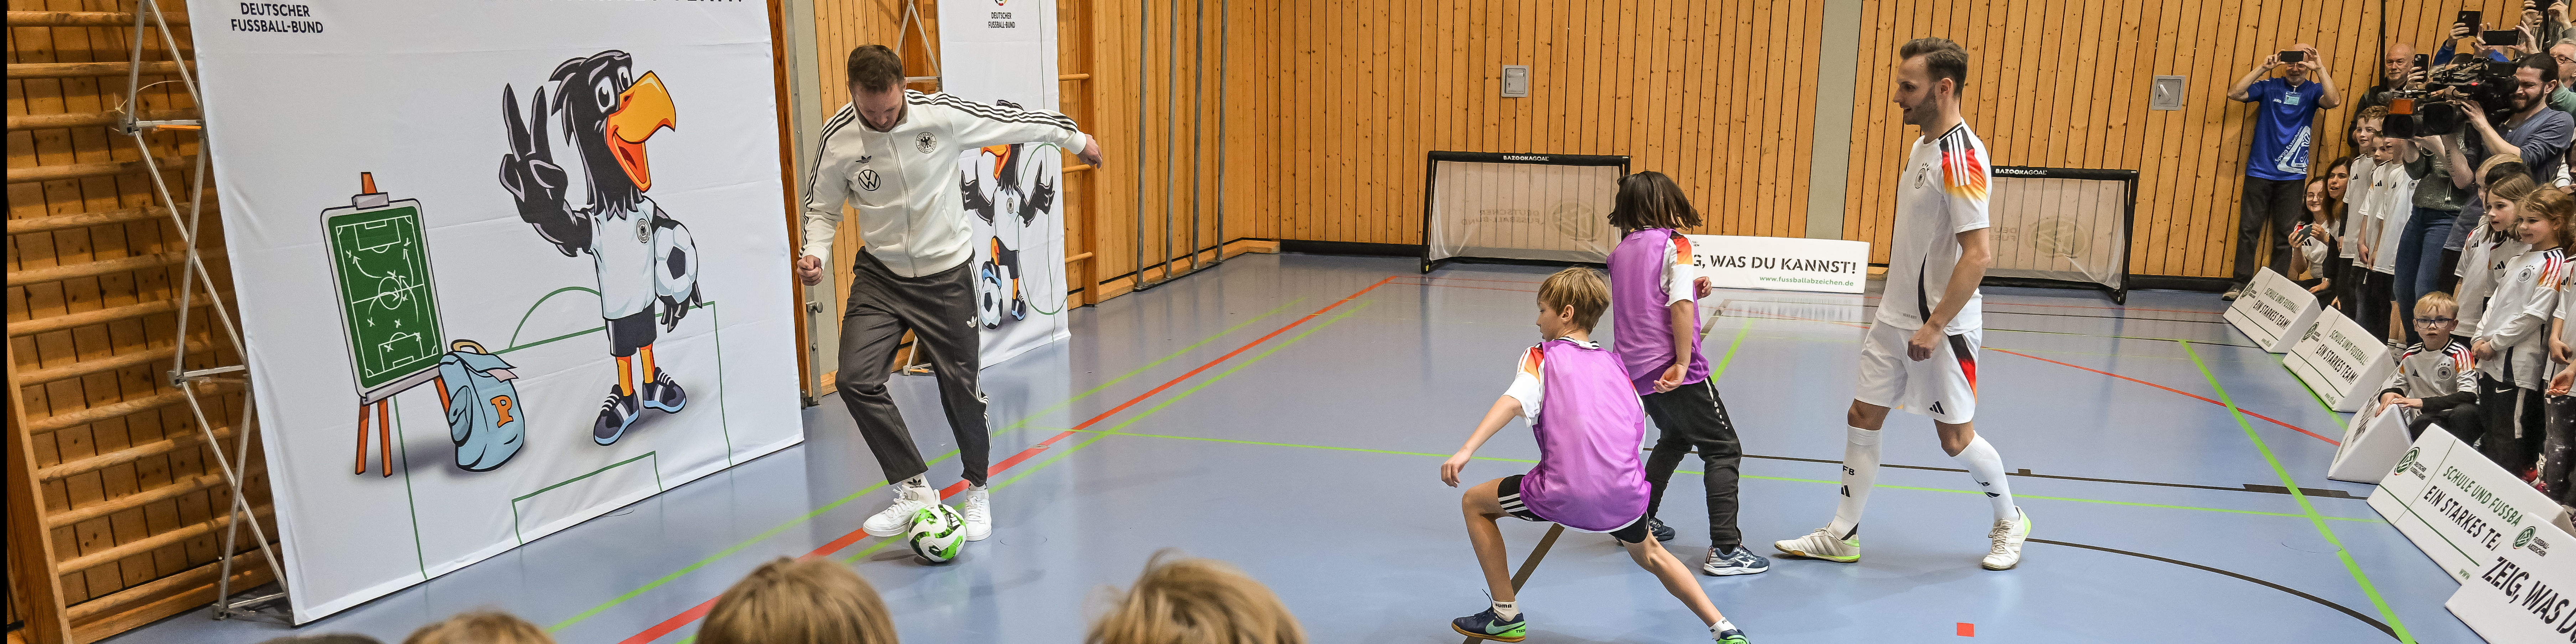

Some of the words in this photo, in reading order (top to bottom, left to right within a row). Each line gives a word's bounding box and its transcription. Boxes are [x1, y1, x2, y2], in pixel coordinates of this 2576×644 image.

[241, 2, 310, 17] DEUTSCHER
[231, 19, 323, 33] FUSSBALL-BUND
[2286, 126, 2303, 150] Essenheim
[1711, 255, 1746, 268] WAS
[1752, 257, 1775, 269] DU
[1781, 258, 1856, 274] KANNST!
[1760, 276, 1854, 286] www.fussballabzeichen.de
[2264, 288, 2279, 302] SCHULE
[2275, 294, 2285, 304] UND
[2253, 300, 2264, 311] EIN
[2259, 304, 2279, 321] STARKES
[2274, 314, 2291, 330] TEAM!
[2329, 330, 2346, 345] SCHULE
[2341, 338, 2353, 351] UND
[2316, 344, 2329, 357] EIN
[2323, 350, 2346, 372] STARKES
[2340, 365, 2359, 385] TEAM!
[2443, 466, 2475, 493] SCHULE
[2471, 485, 2492, 504] UND
[2423, 485, 2446, 507] EIN
[2440, 498, 2487, 537] STARKES
[2481, 556, 2530, 604] ZEIG,
[2521, 580, 2570, 624] WAS
